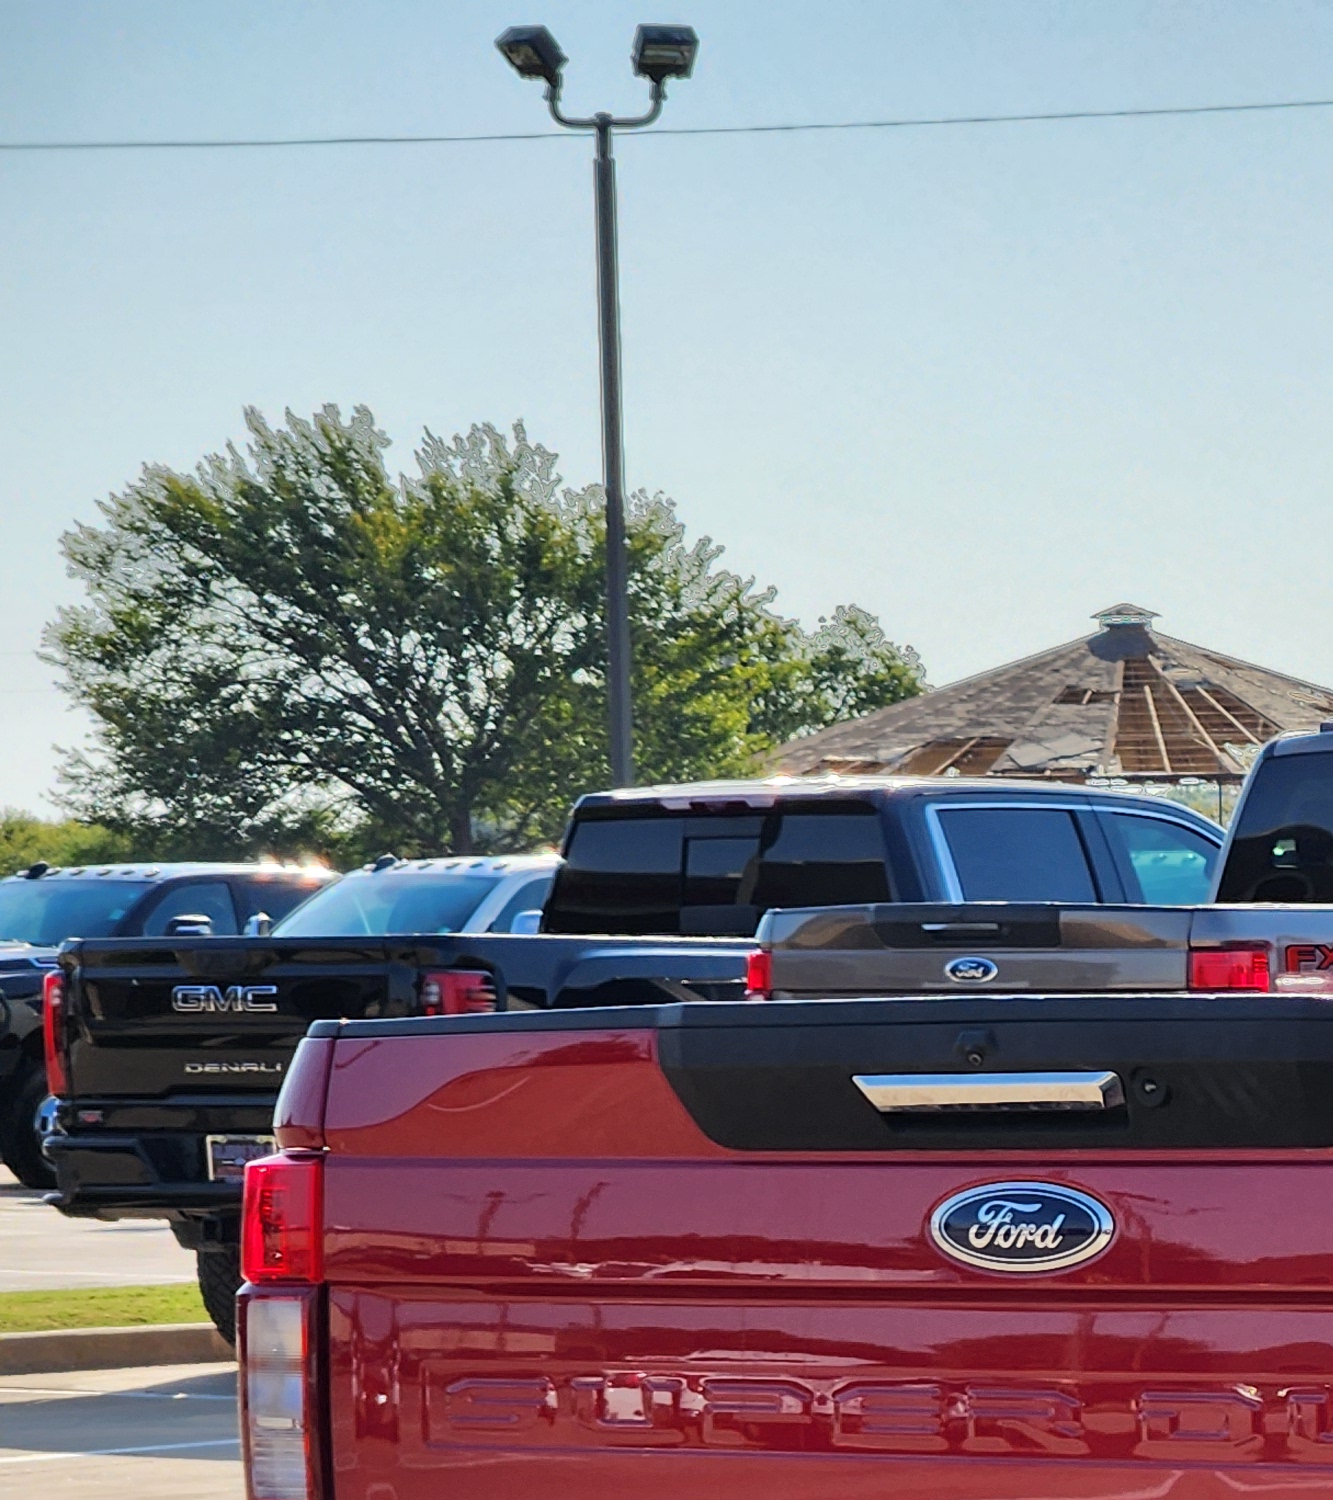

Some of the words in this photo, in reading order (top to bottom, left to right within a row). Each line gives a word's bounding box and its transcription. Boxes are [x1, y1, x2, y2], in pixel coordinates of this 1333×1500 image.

[172, 984, 278, 1013] GMC
[184, 1062, 282, 1074] DENALI
[968, 1200, 1066, 1249] Ford
[444, 1375, 1090, 1455] SUPER
